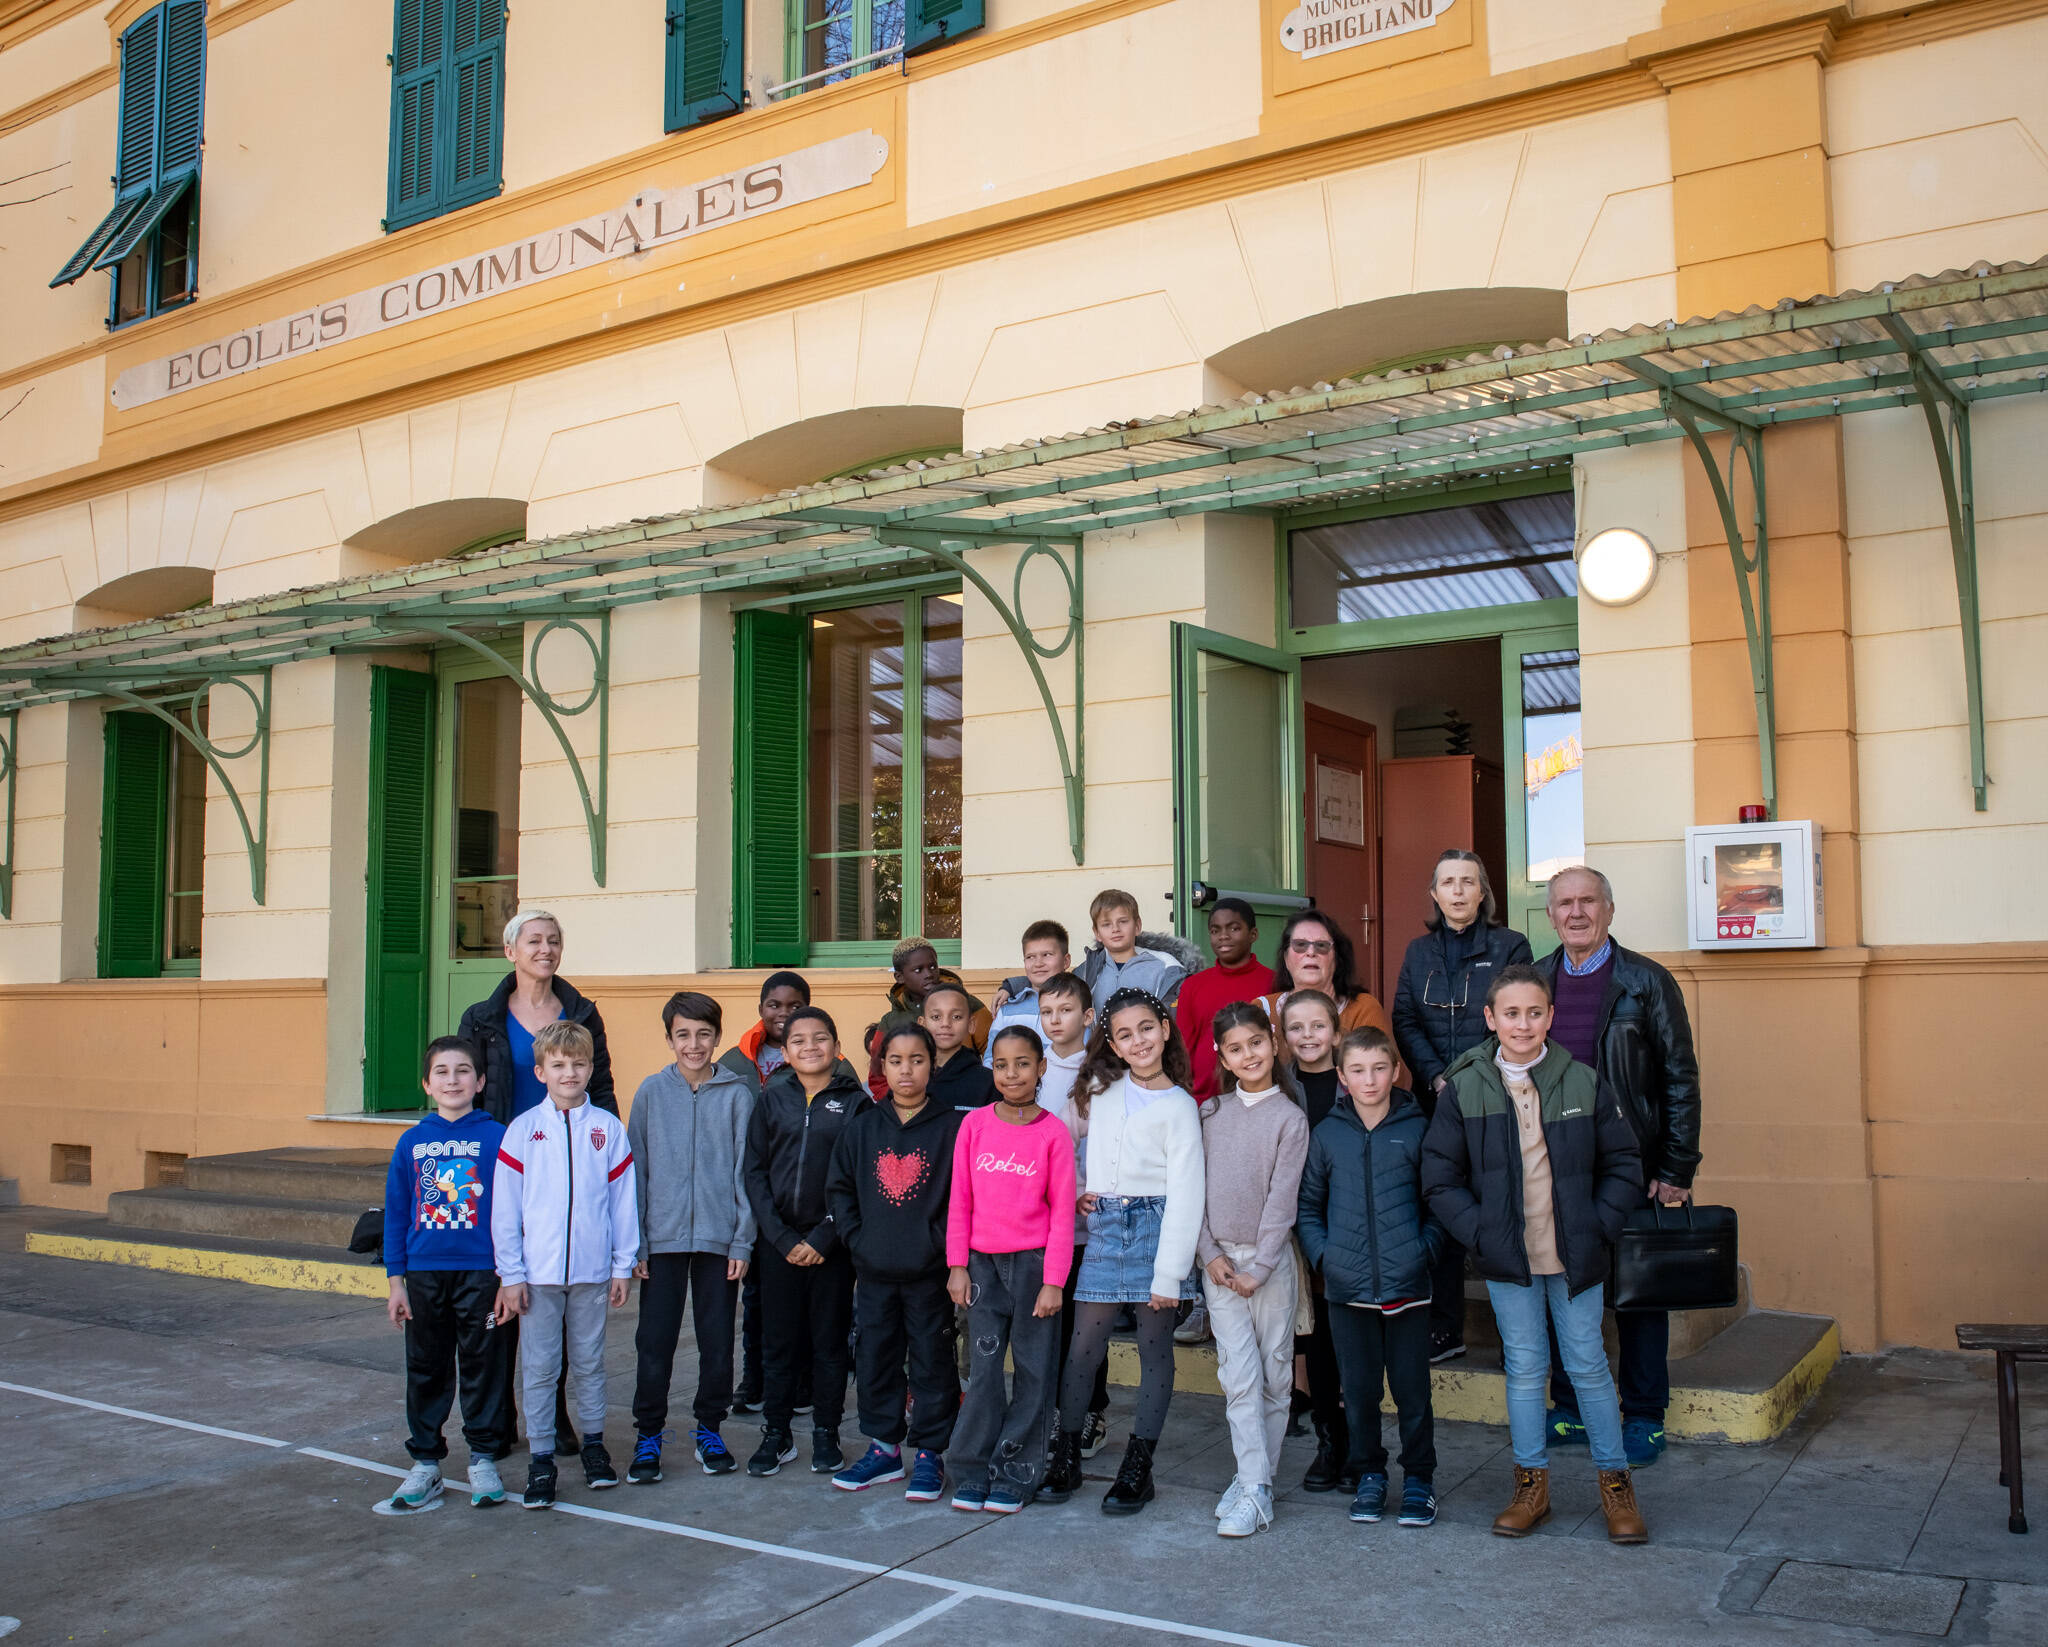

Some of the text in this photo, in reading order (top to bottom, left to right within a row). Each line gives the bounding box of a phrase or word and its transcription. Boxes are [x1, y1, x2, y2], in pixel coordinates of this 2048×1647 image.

[1303, 0, 1433, 50] BRIGLIANO
[167, 164, 783, 391] ECOLES COMMUNALES
[976, 1152, 1038, 1176] Rebel
